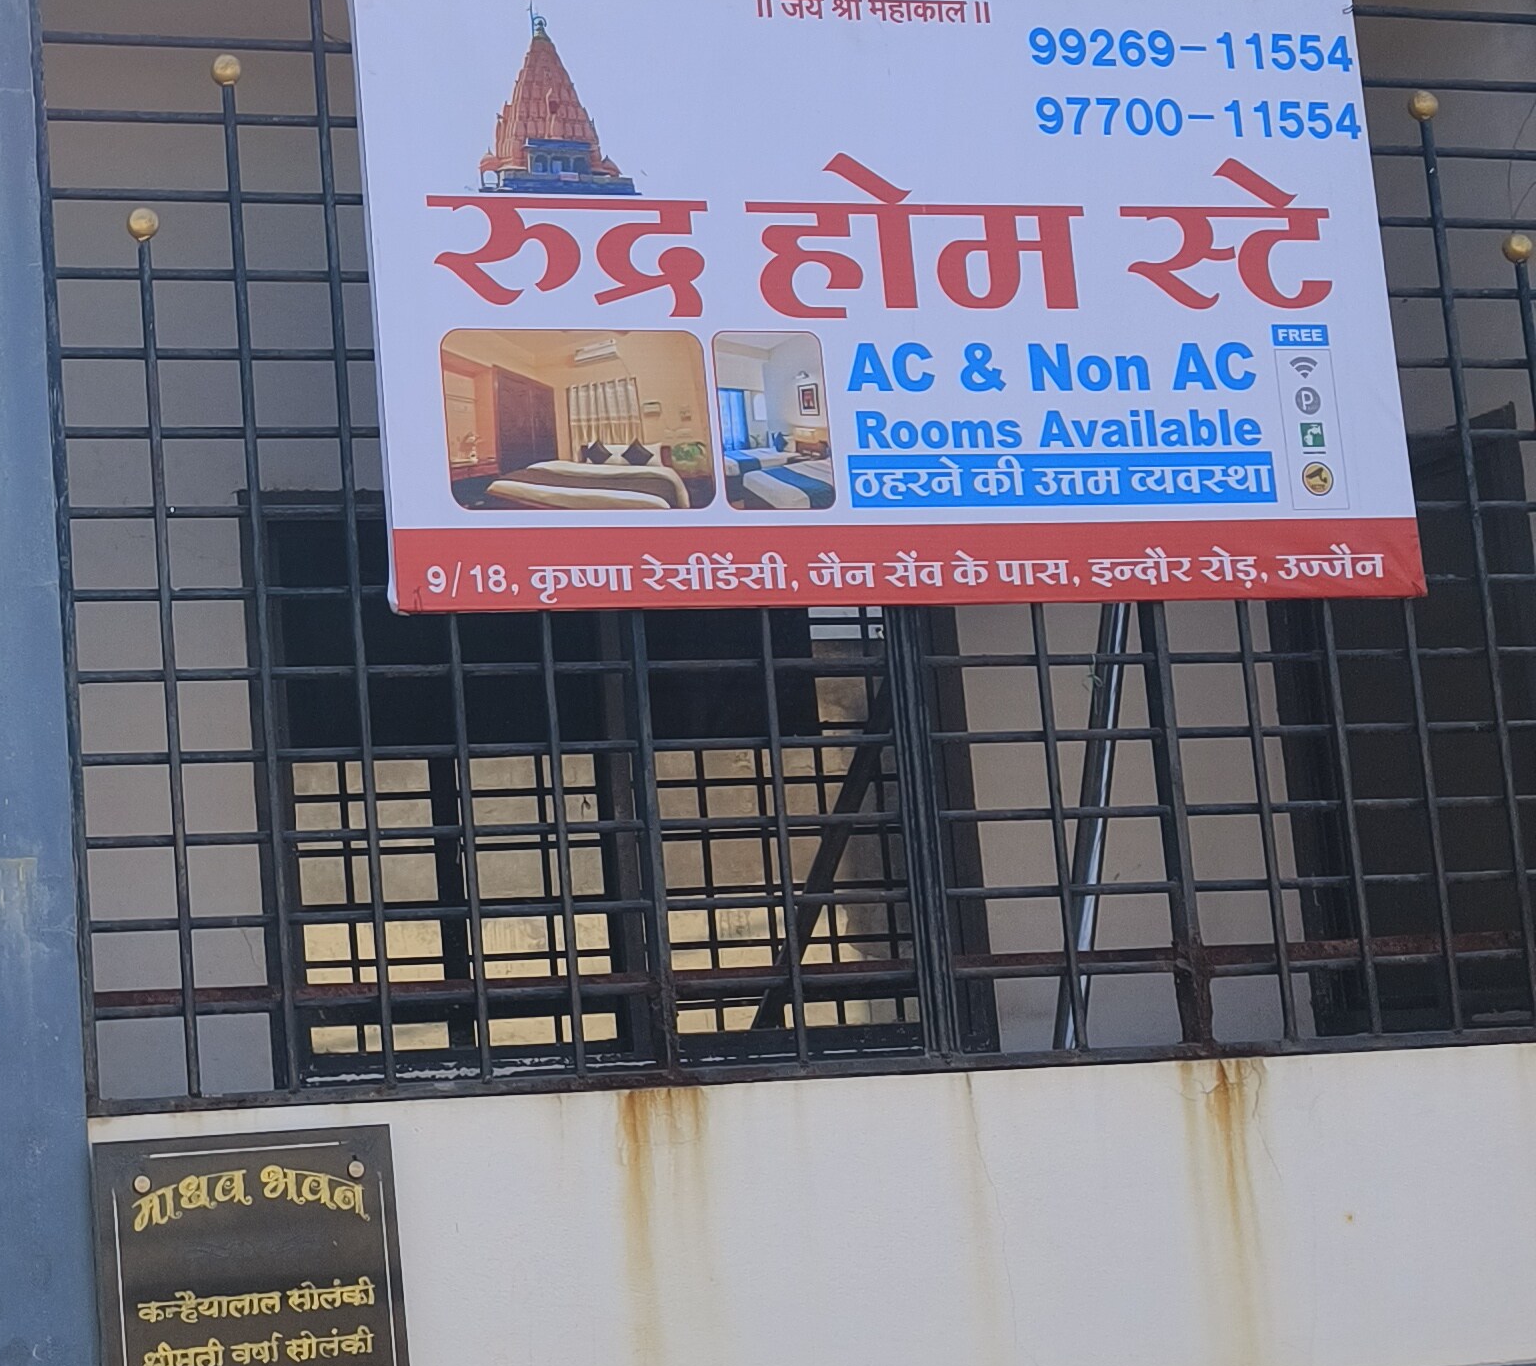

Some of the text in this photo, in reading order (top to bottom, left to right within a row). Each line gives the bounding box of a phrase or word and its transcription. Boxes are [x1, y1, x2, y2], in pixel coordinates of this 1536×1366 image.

[868, 0, 966, 24] महाकाल
[1028, 27, 1353, 72] 99269-11554
[1035, 97, 1362, 140] 97700-11554
[427, 152, 1333, 319] रुद्र होम स्टे
[1277, 328, 1323, 342] FREE
[847, 342, 1257, 392] AC & Non AC
[856, 409, 1263, 449] Rooms Available
[851, 456, 1272, 500] ठहरने की उत्तम व्यवस्था
[426, 561, 520, 598] 9/18,
[529, 565, 633, 604] कृष्णा
[641, 552, 799, 593] रेसीडेंसी,
[808, 553, 875, 589] जैन
[950, 551, 989, 586] के
[998, 560, 1081, 587] पास,
[1091, 548, 1192, 585] इन्दौर
[1276, 545, 1384, 580] उज्जैन
[132, 1164, 371, 1232] माधव भवन
[286, 1276, 375, 1313] सोलंकी
[230, 1332, 283, 1365] वर्षा
[285, 1325, 374, 1362] सोलंकी
